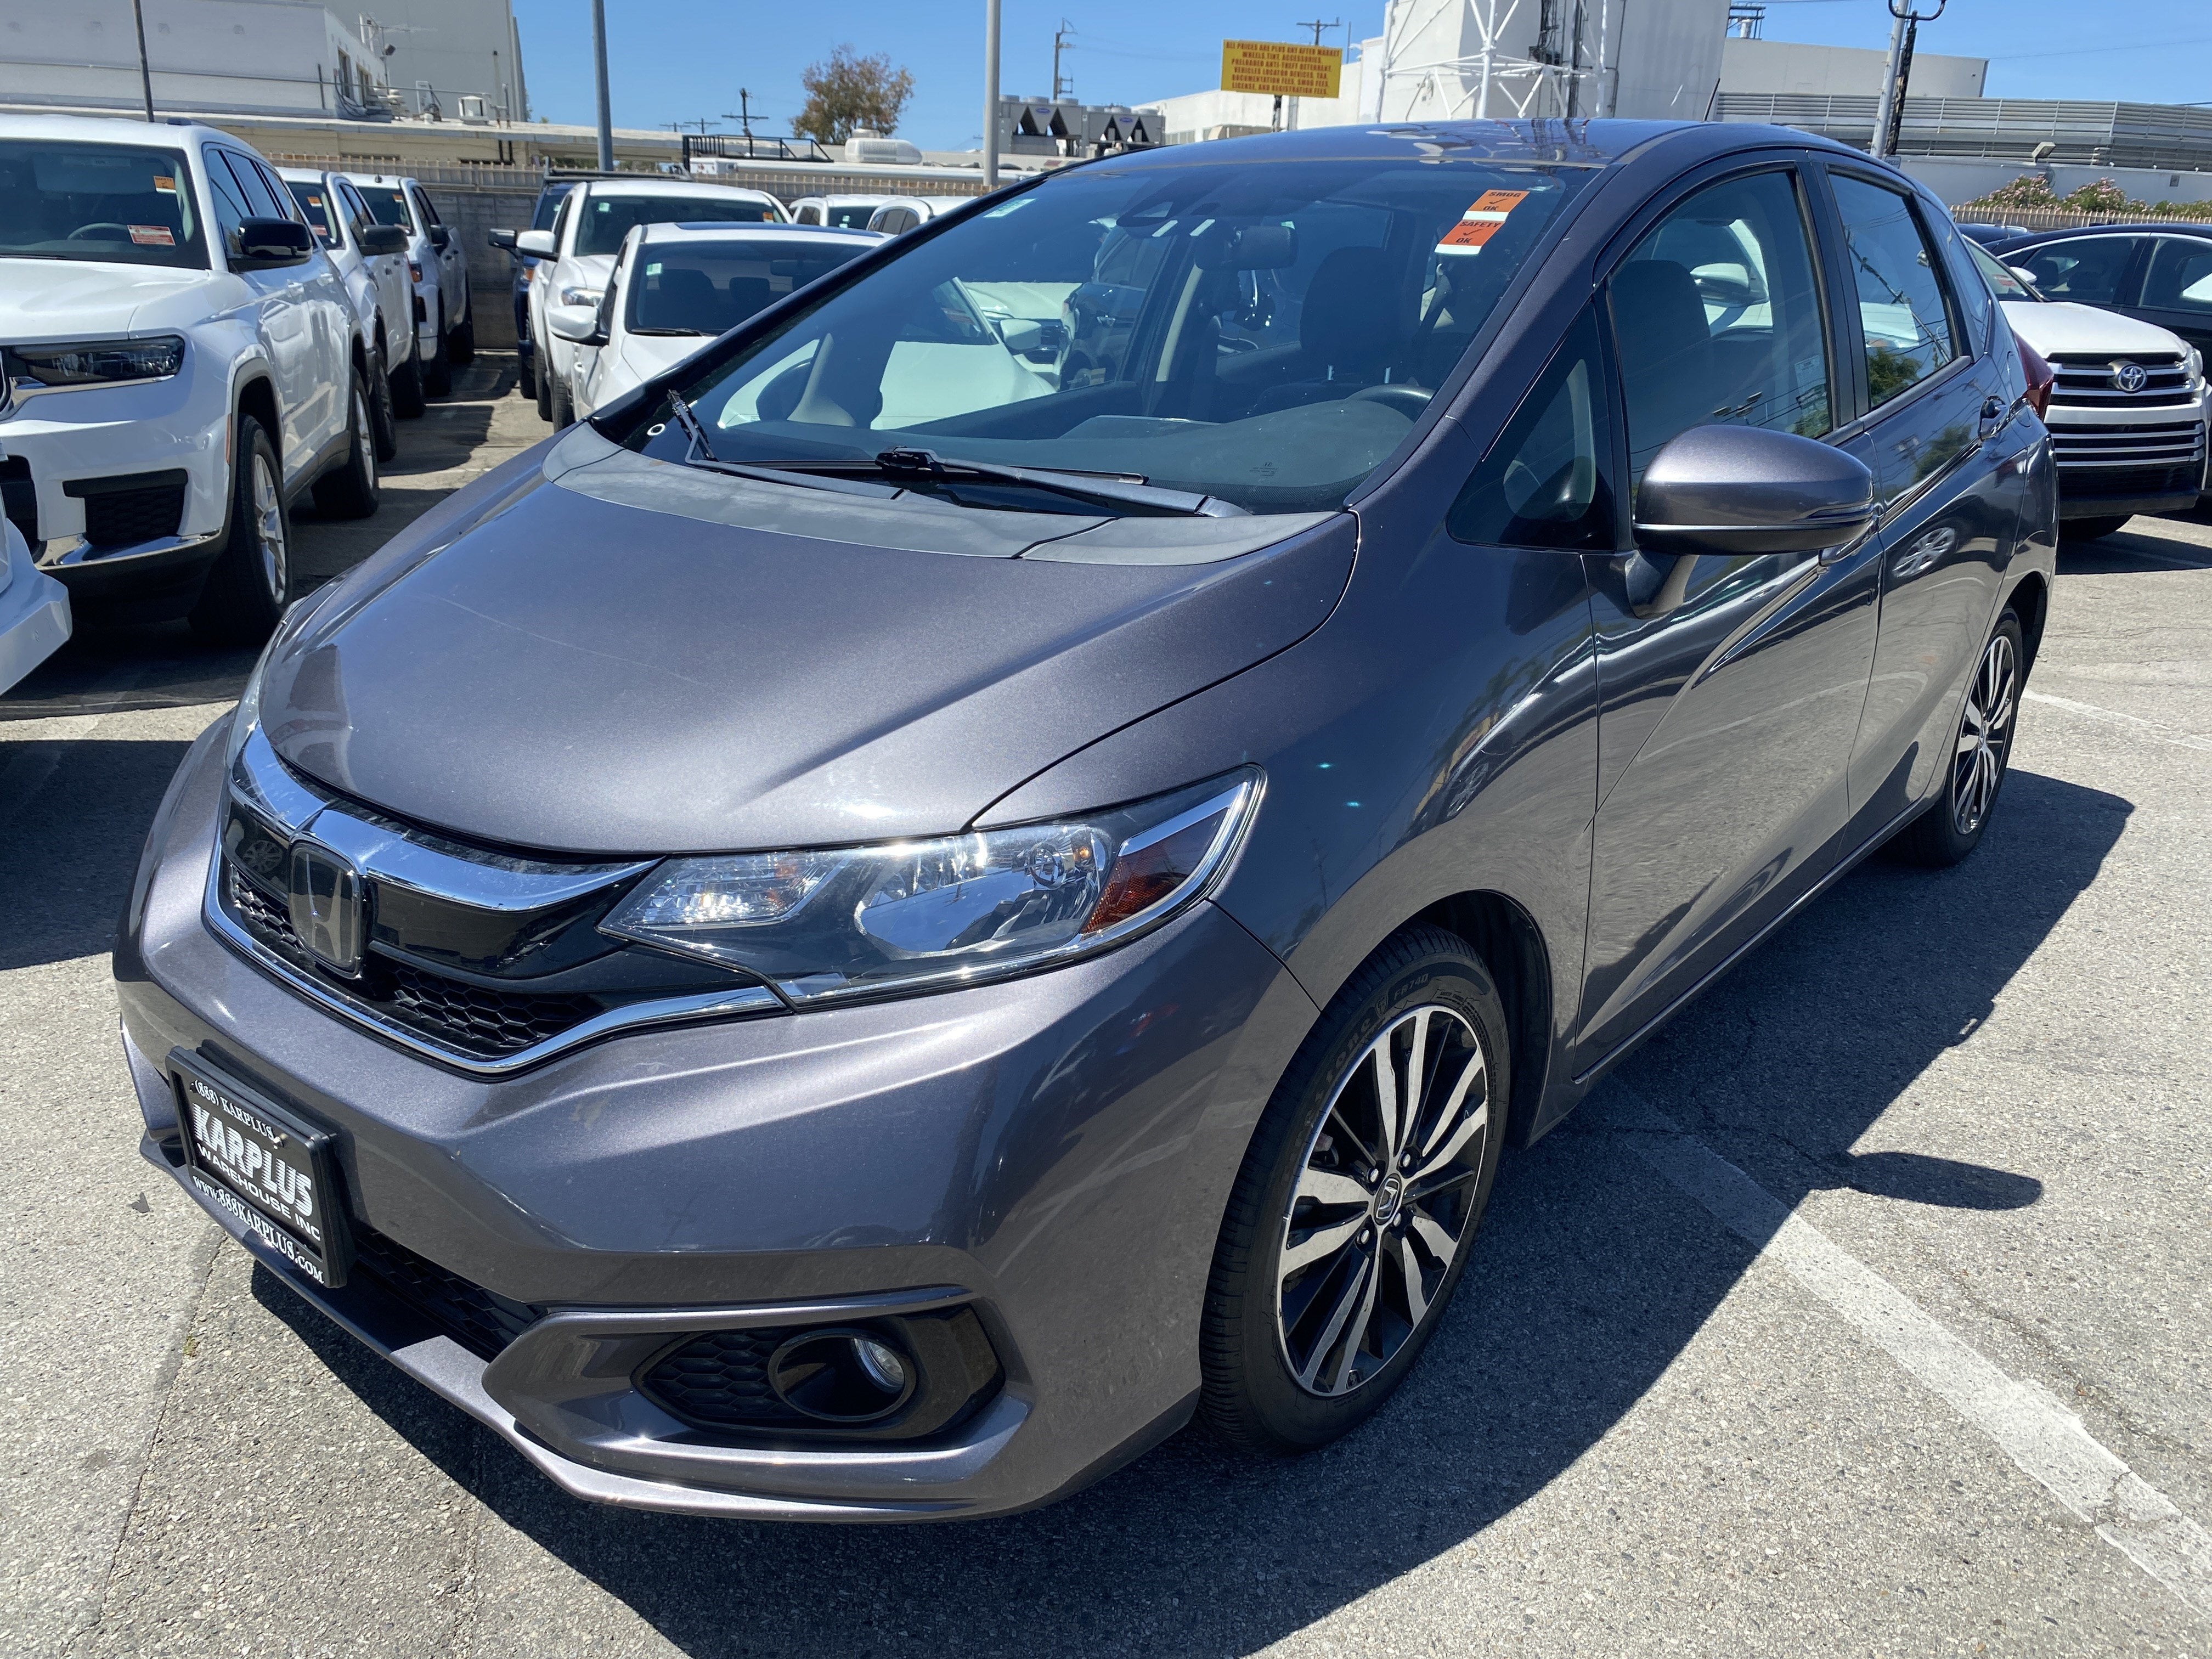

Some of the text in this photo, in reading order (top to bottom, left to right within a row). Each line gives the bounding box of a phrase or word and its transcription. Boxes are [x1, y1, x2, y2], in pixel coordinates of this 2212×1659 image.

[192, 1103, 313, 1217] KARPLUS
[194, 1080, 274, 1141] (888) KARPLUS
[197, 1142, 321, 1241] WAREHOUSE INC
